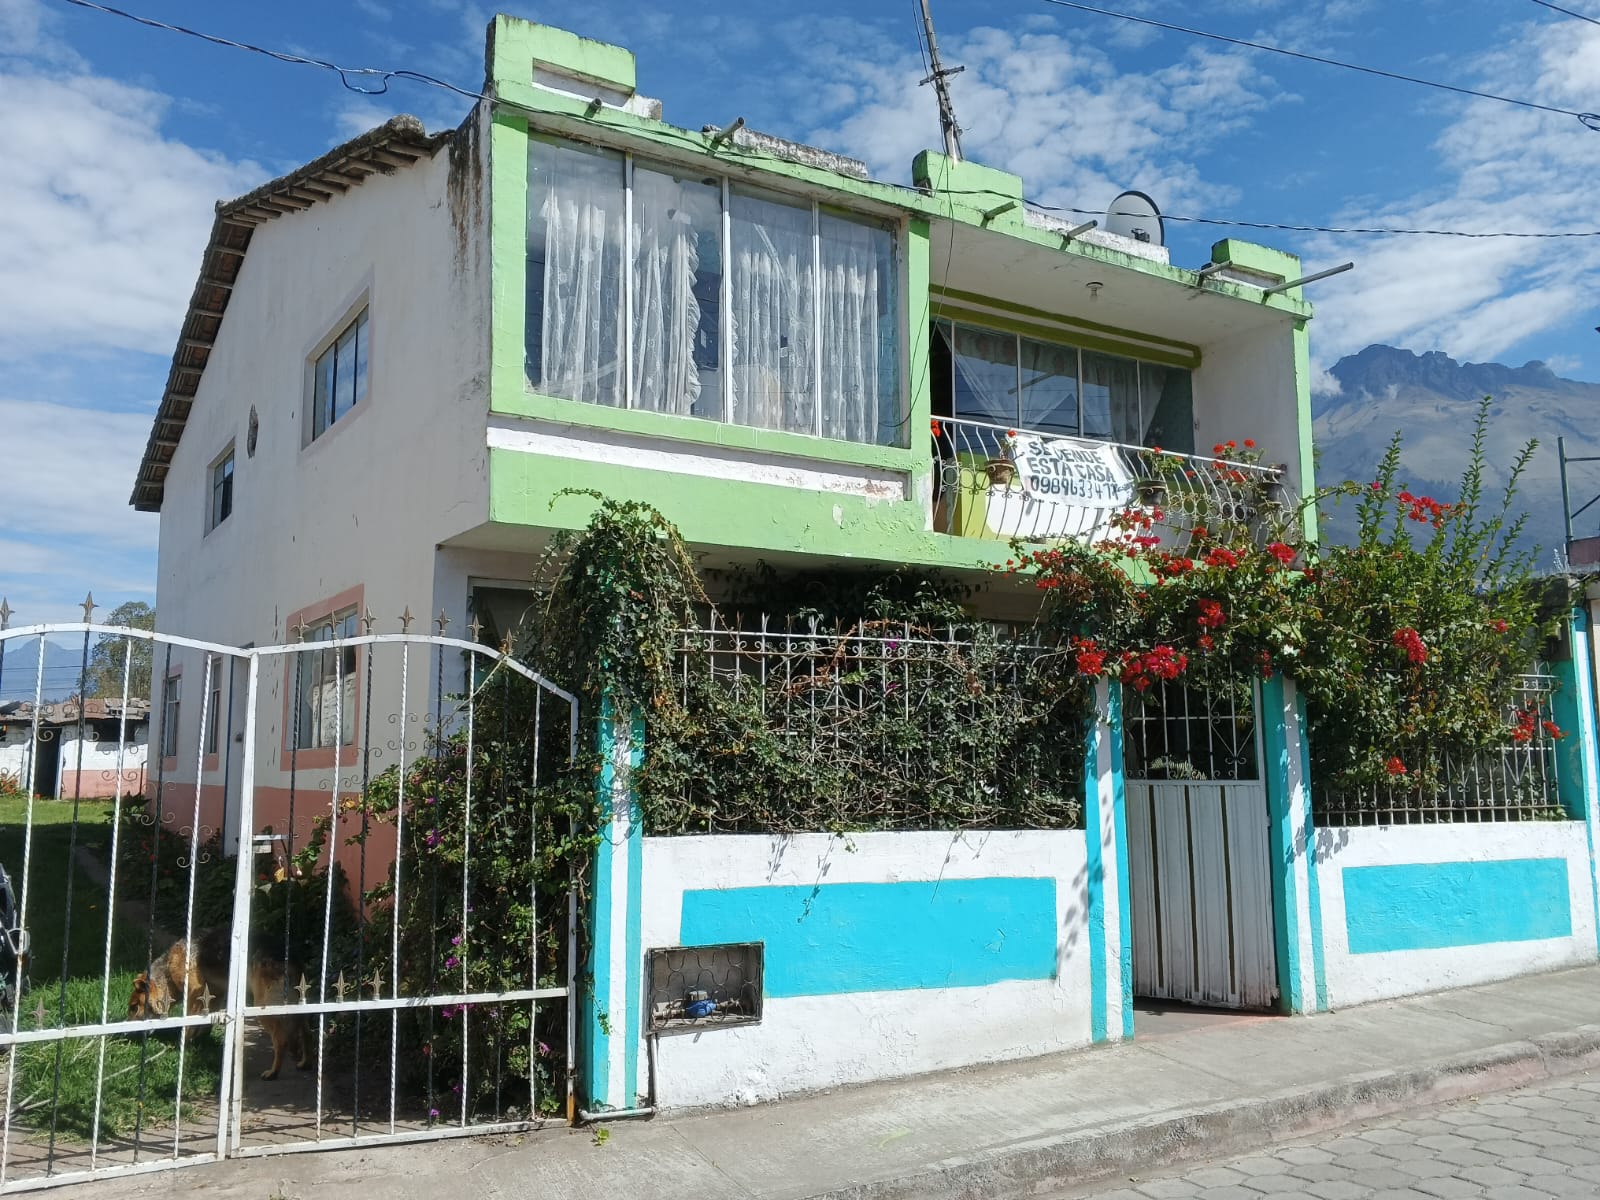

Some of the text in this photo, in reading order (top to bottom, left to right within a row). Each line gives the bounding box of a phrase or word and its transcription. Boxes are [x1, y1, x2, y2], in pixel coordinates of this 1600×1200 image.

[1028, 441, 1105, 465] SE VENDE
[1026, 457, 1117, 483] ESTA CASA
